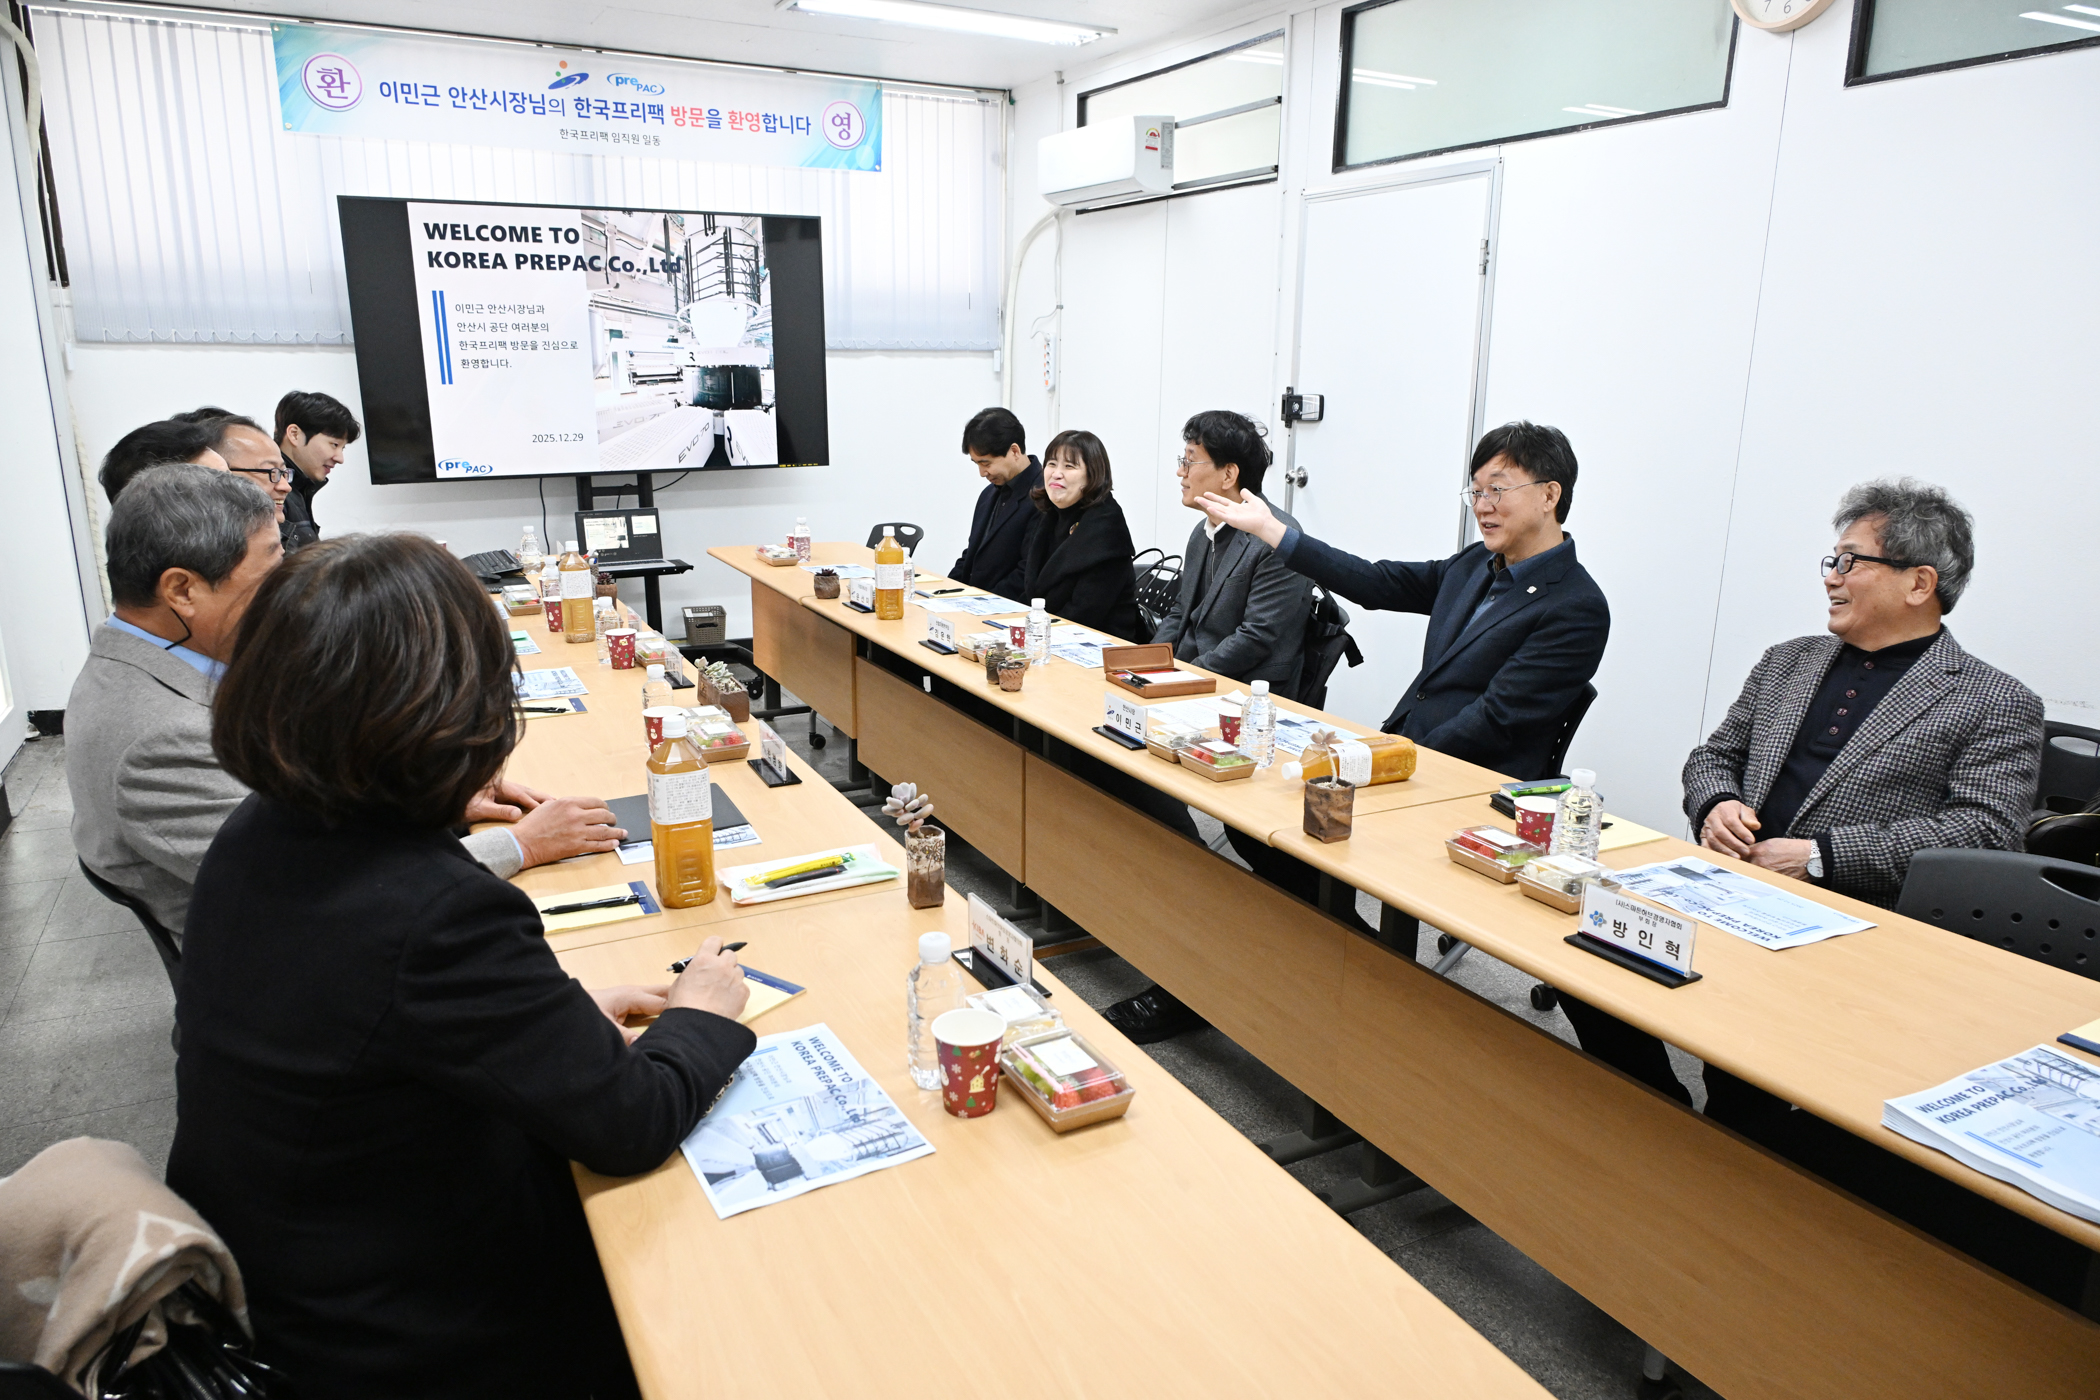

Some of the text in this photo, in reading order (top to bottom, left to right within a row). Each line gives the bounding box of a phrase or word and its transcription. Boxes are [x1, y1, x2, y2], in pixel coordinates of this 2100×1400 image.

[316, 67, 351, 100] 환
[379, 81, 812, 136] 이민근 안산시장님의 한국프리팩 방문을 환영합니다
[831, 111, 851, 141] 영
[559, 128, 661, 147] 한국프리팩 임직원 일동
[423, 222, 580, 244] WELCOME TO
[427, 251, 682, 275] KOREA PREPAC Co.,Ltd
[455, 303, 545, 315] 이민근 안산시장님과
[456, 322, 549, 333] 안산시 공단 여러분의
[458, 340, 579, 351] 한국프리팩 방문을 진심으로
[460, 358, 513, 369] 환영합니다.
[532, 433, 584, 443] 2025.12.29
[790, 1040, 817, 1066] KOREA
[808, 1036, 854, 1084] WELCOME TO
[1915, 1085, 1987, 1114] WELCOME TO
[1935, 1107, 1976, 1125] KOREA
